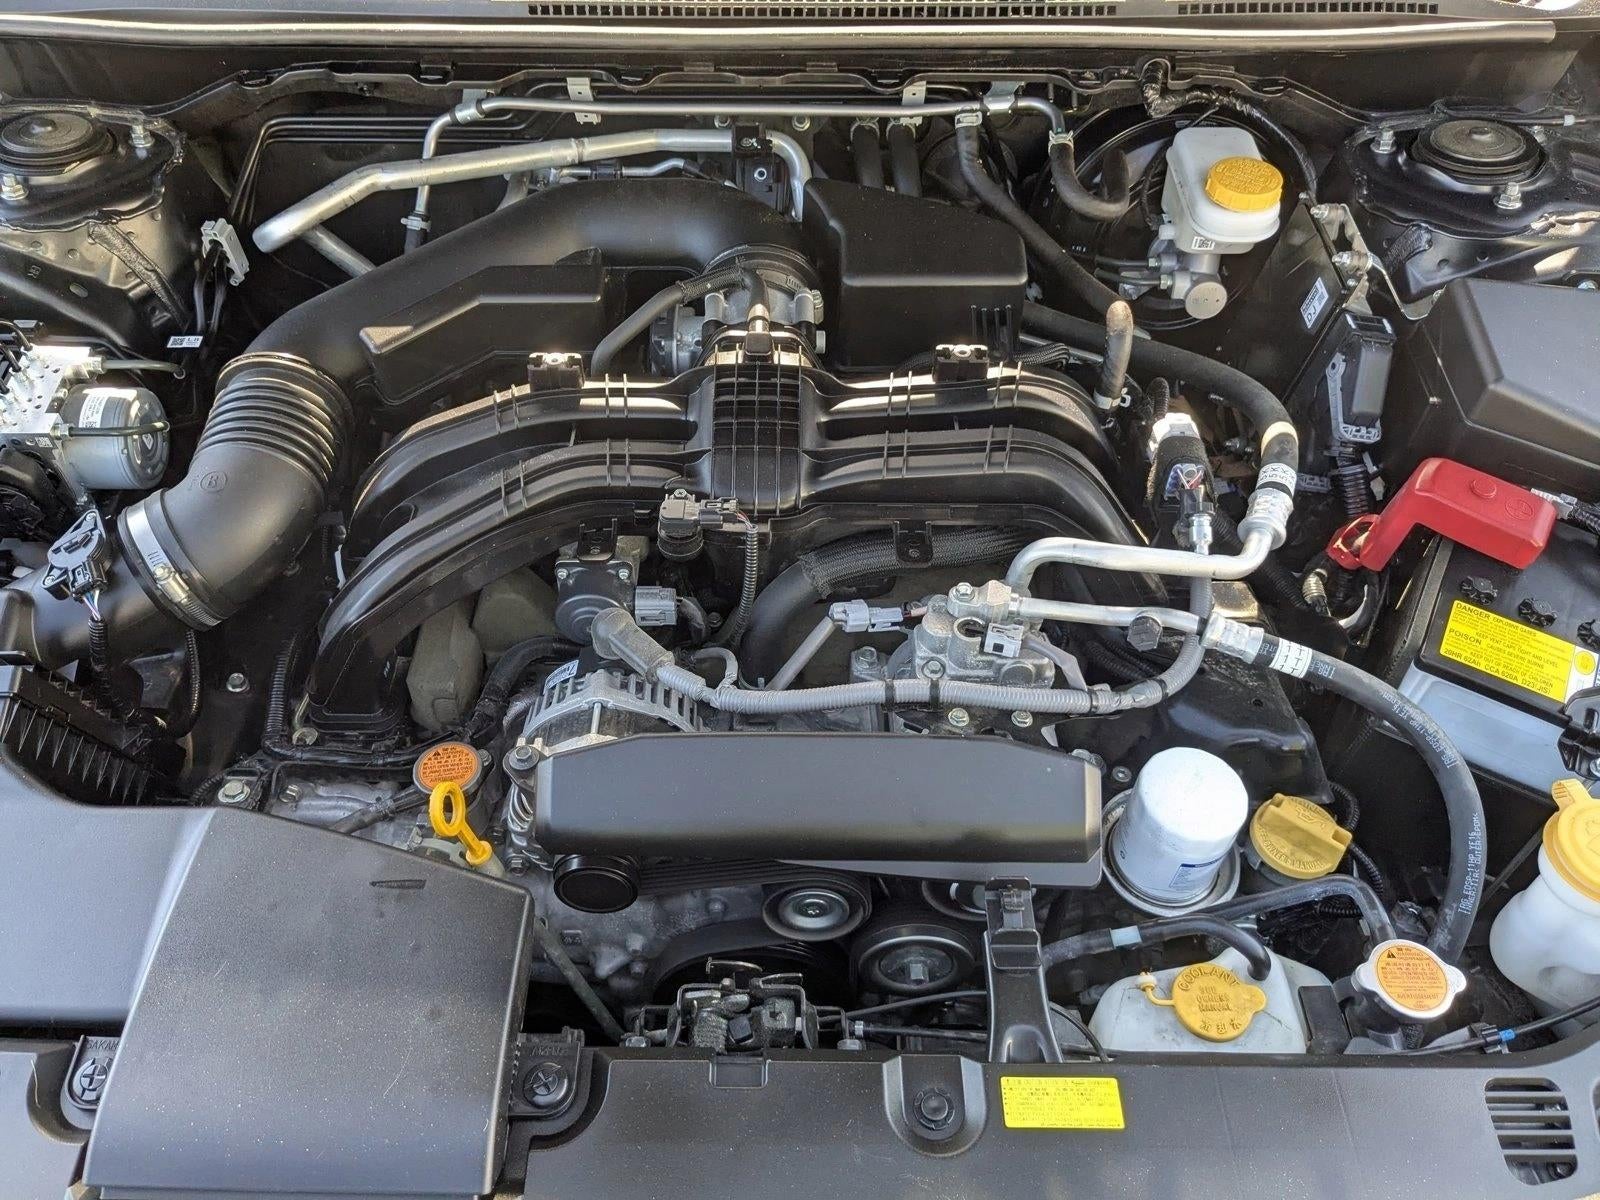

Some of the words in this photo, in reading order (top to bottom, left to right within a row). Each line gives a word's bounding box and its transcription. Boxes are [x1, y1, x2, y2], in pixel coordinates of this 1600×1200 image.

[1455, 602, 1490, 619] DANGER
[1447, 628, 1482, 645] POISON
[1483, 663, 1501, 675] CCA
[1177, 966, 1241, 992] COOLANT
